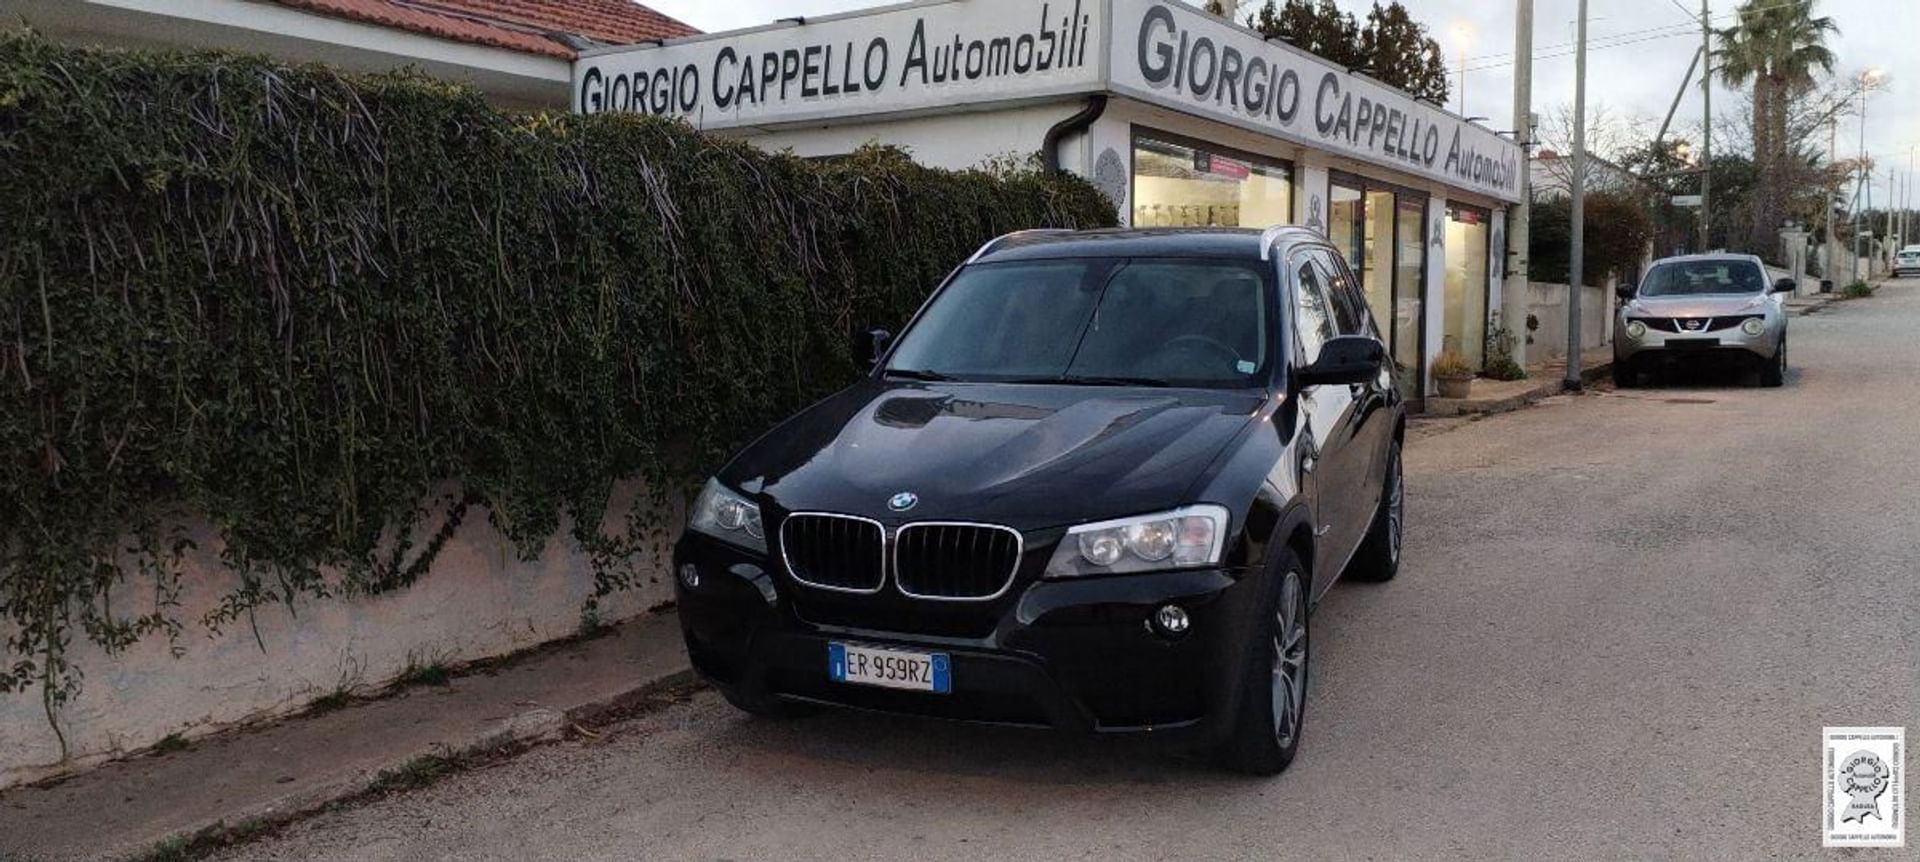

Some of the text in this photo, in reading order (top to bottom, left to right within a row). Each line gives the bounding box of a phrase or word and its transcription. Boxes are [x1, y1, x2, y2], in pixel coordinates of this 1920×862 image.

[581, 0, 1089, 115] GIORGIO CAPPELLO Automobili
[1138, 5, 1300, 122] GIORGIO
[1315, 72, 1438, 165] CAPPELLO
[846, 653, 932, 683] ER 959RZ
